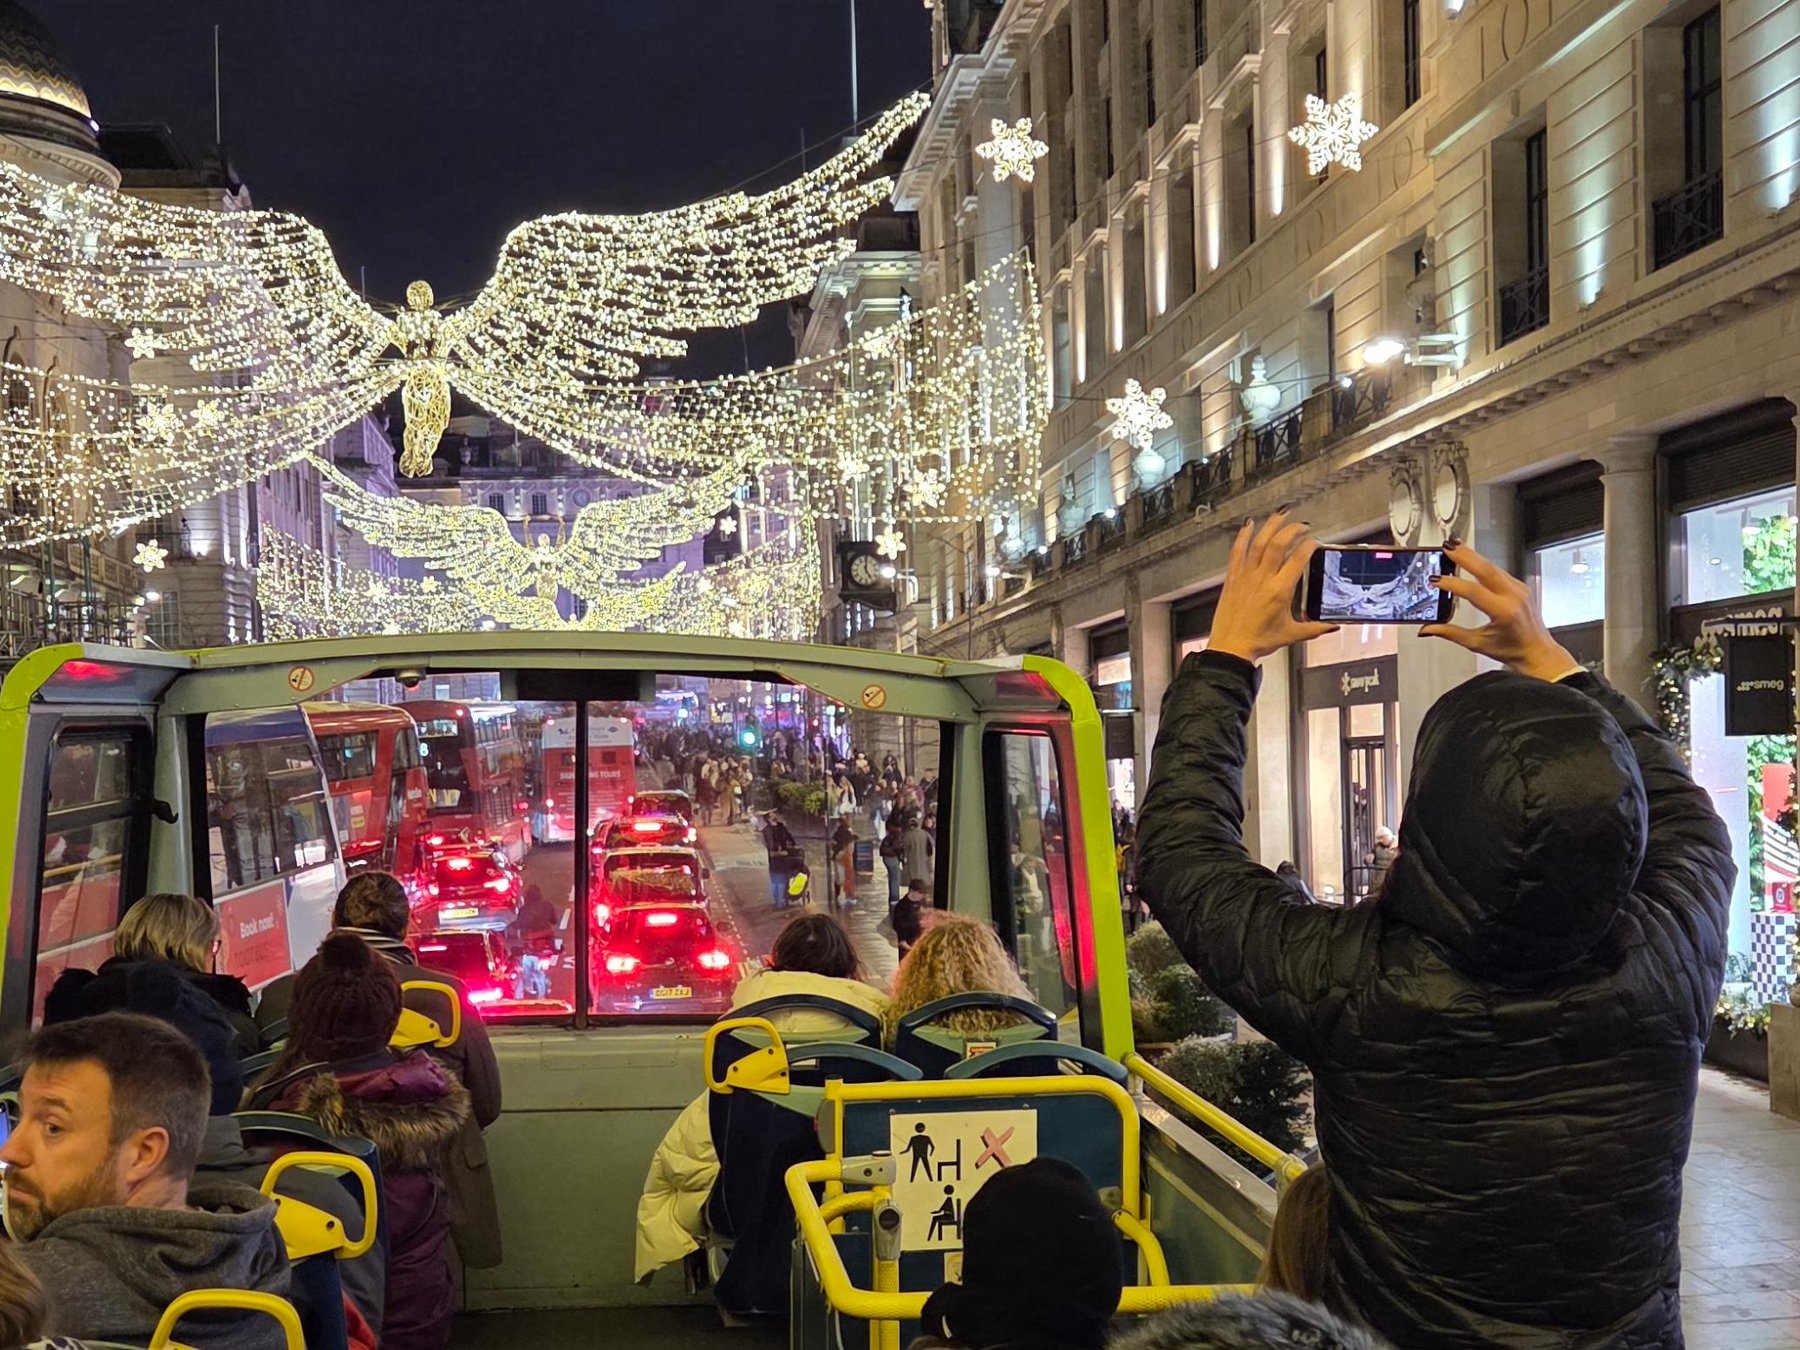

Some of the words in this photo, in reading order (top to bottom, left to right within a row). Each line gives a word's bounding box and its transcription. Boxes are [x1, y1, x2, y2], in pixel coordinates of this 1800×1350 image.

[1753, 680, 1784, 691] smeg
[600, 770, 621, 778] TOURS
[240, 917, 258, 939] Book
[258, 912, 275, 932] now!
